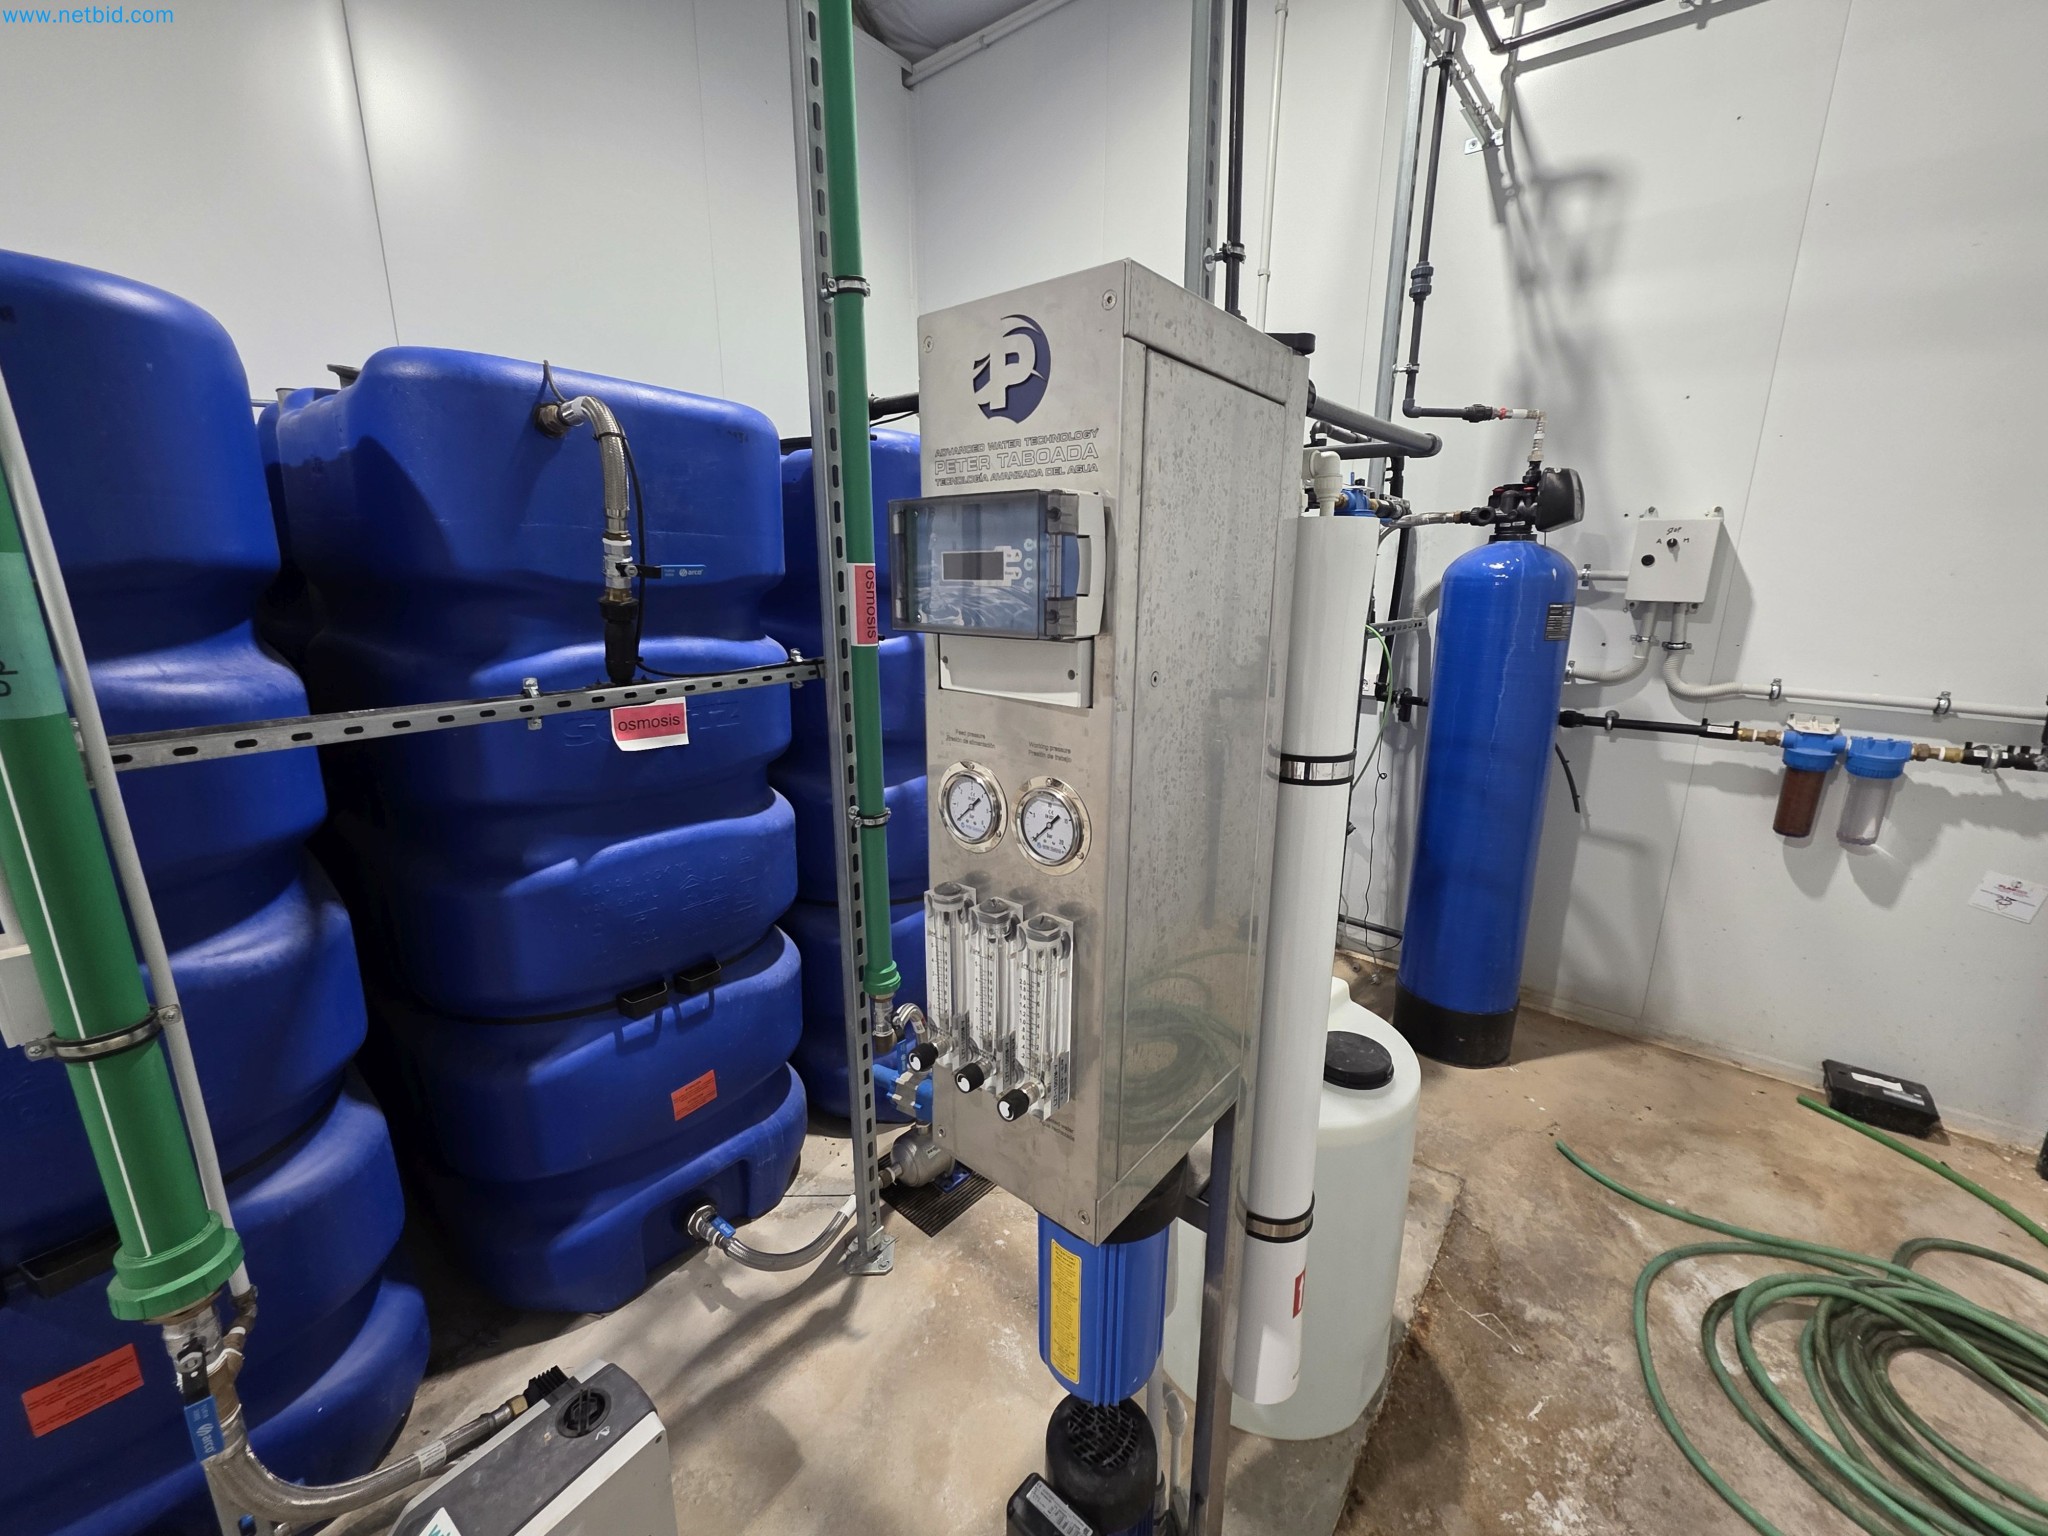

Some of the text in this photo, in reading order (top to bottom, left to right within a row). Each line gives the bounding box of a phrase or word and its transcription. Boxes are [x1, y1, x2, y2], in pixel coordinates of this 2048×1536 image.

[935, 428, 1099, 458] ADVANCED WATER TECHNOLOGY
[935, 443, 1099, 475] PETER TABOADA
[990, 469, 1043, 482] AVANZADA
[1045, 467, 1065, 476] DEL
[1067, 463, 1098, 475] AGUA
[865, 570, 877, 639] osmosis
[618, 713, 681, 732] osmosis
[1029, 742, 1071, 754] Working pressure
[202, 1434, 215, 1453] arco
